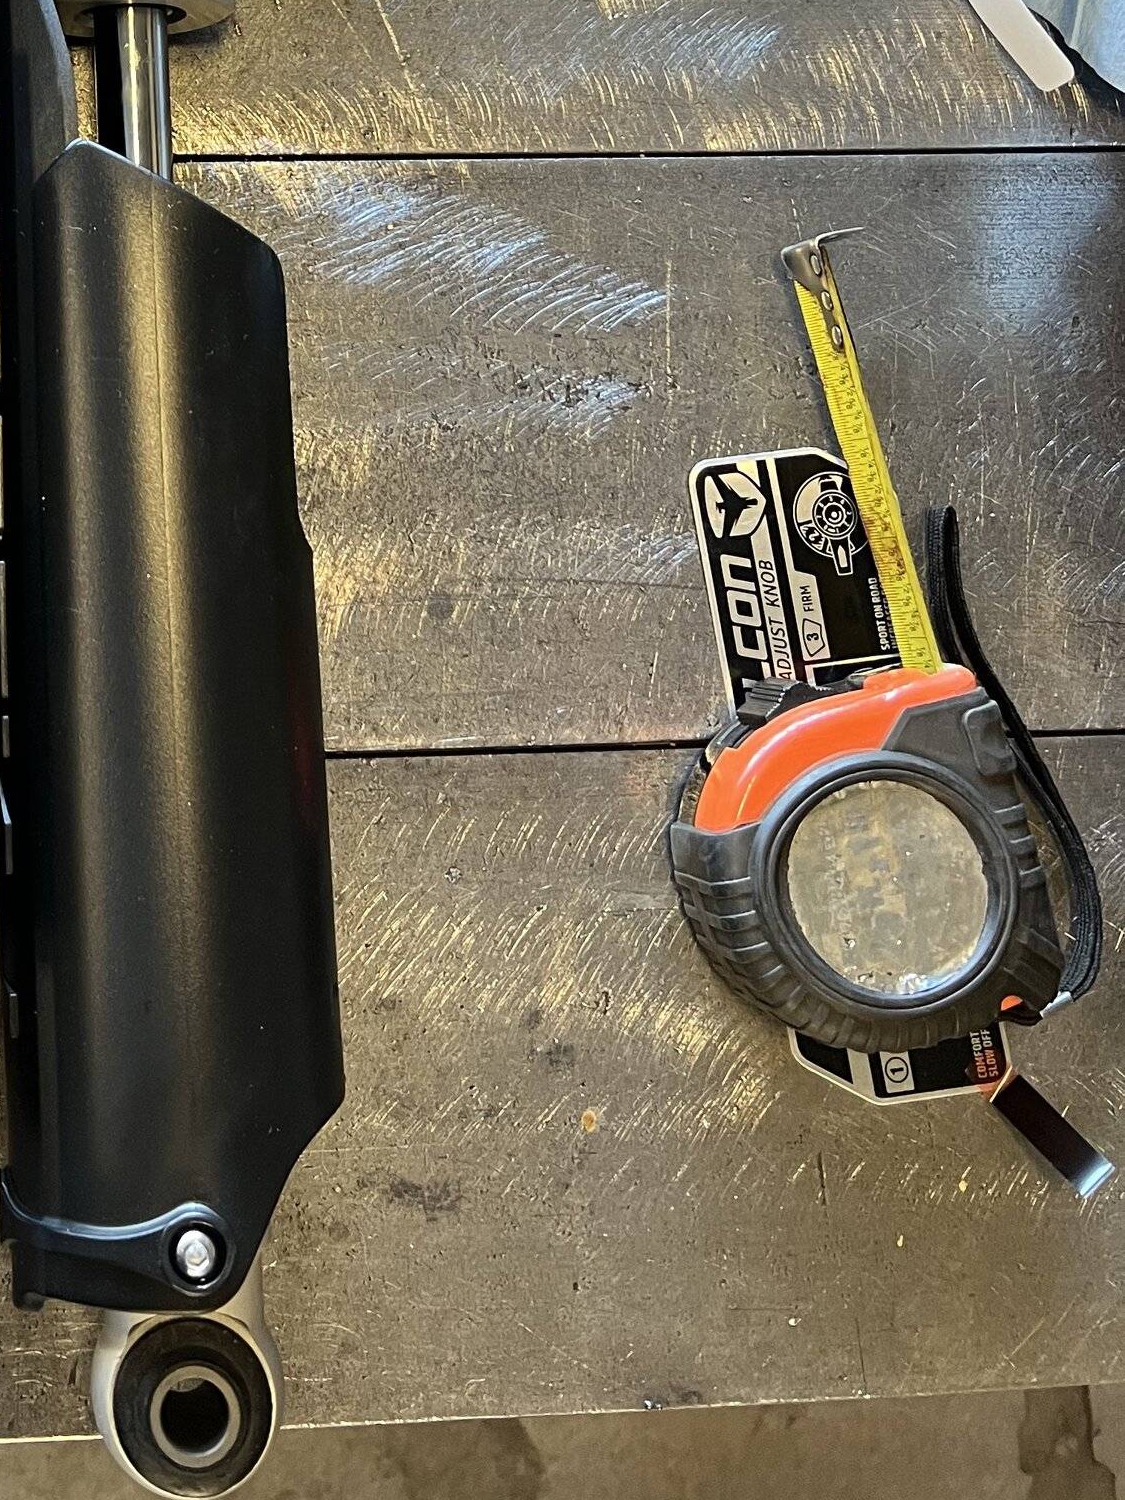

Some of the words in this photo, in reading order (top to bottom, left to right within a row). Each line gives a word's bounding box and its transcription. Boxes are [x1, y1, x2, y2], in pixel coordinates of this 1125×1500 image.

[758, 559, 782, 609] KNOB
[867, 577, 881, 603] ROAD
[799, 584, 815, 613] FIRM
[873, 604, 884, 619] ON
[766, 615, 792, 680] ADJUST
[805, 632, 820, 642] 3
[876, 619, 891, 651] SPORT
[981, 1029, 993, 1048] OFF
[970, 1031, 987, 1078] COMFORT
[983, 1050, 999, 1077] SLOW
